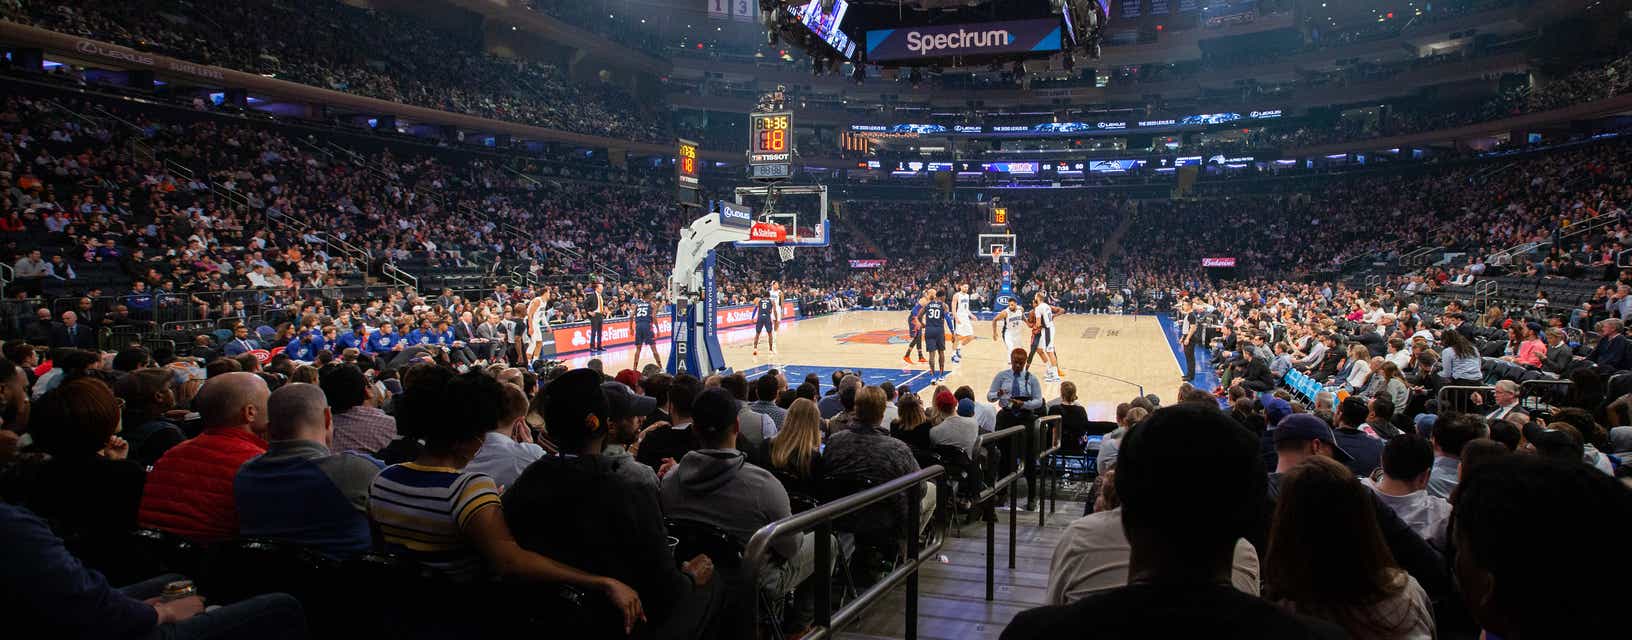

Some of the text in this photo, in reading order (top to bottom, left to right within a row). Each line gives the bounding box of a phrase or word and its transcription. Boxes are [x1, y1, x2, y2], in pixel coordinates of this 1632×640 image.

[907, 28, 1008, 55] Spectrum
[98, 47, 153, 65] LEXUS
[766, 130, 785, 150] 18
[763, 153, 789, 161] TISSOT
[636, 308, 648, 317] 25
[928, 309, 940, 319] 30
